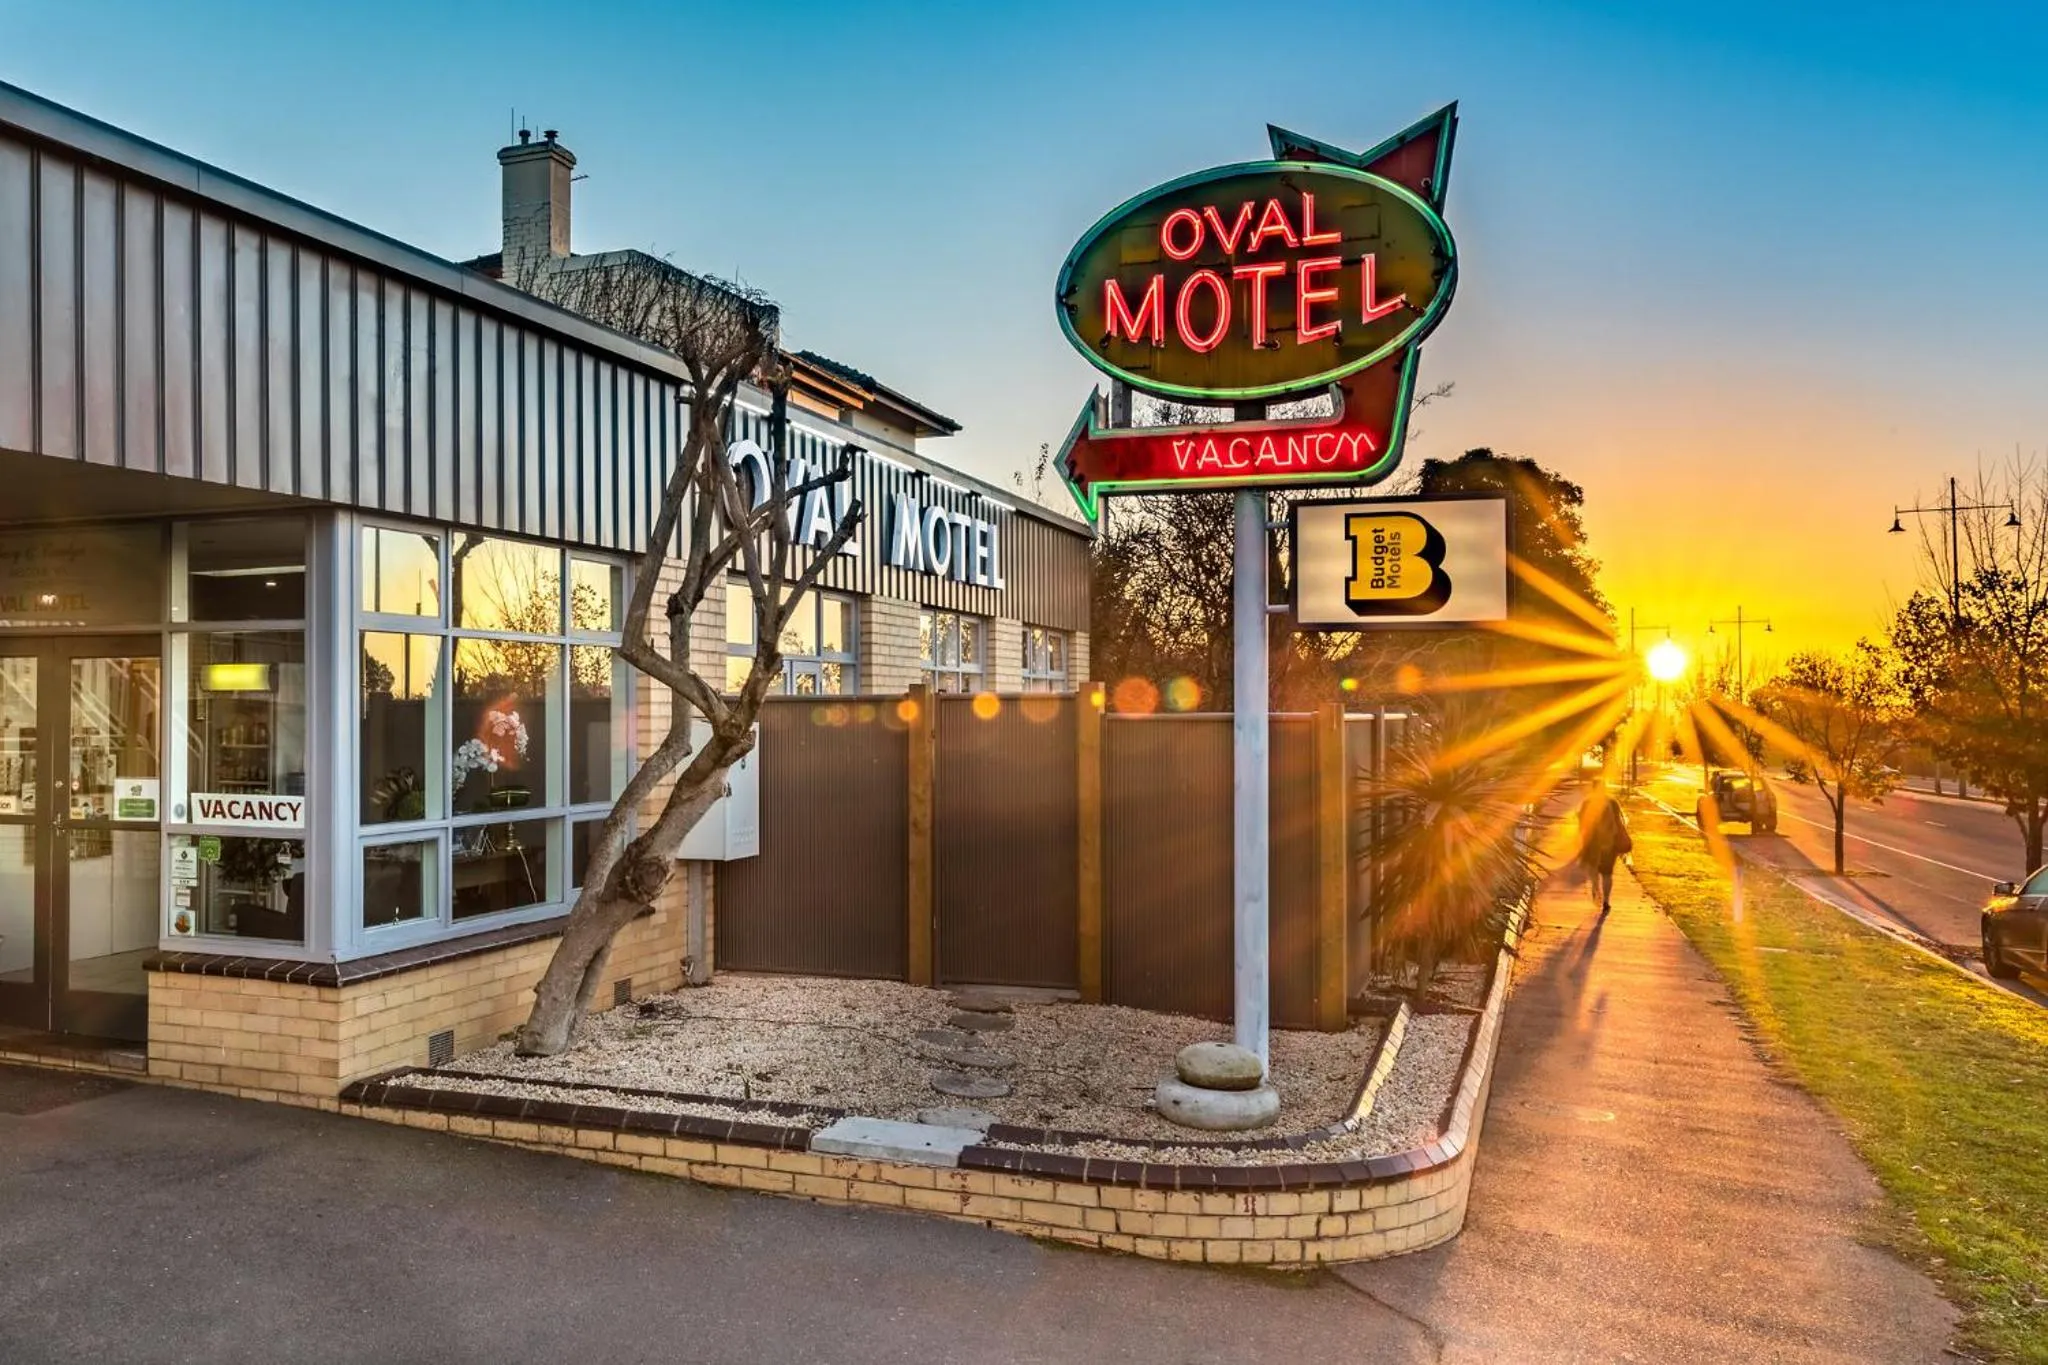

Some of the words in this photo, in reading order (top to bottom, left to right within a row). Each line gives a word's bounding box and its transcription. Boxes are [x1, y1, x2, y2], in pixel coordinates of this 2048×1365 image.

[1161, 192, 1342, 260] OVAL
[1105, 253, 1407, 354] MOTEL
[1173, 432, 1376, 470] VACANCY
[890, 492, 1005, 591] MOTEL
[1370, 528, 1388, 589] Budget
[1387, 531, 1401, 589] Motels
[198, 799, 302, 822] VACANCY
